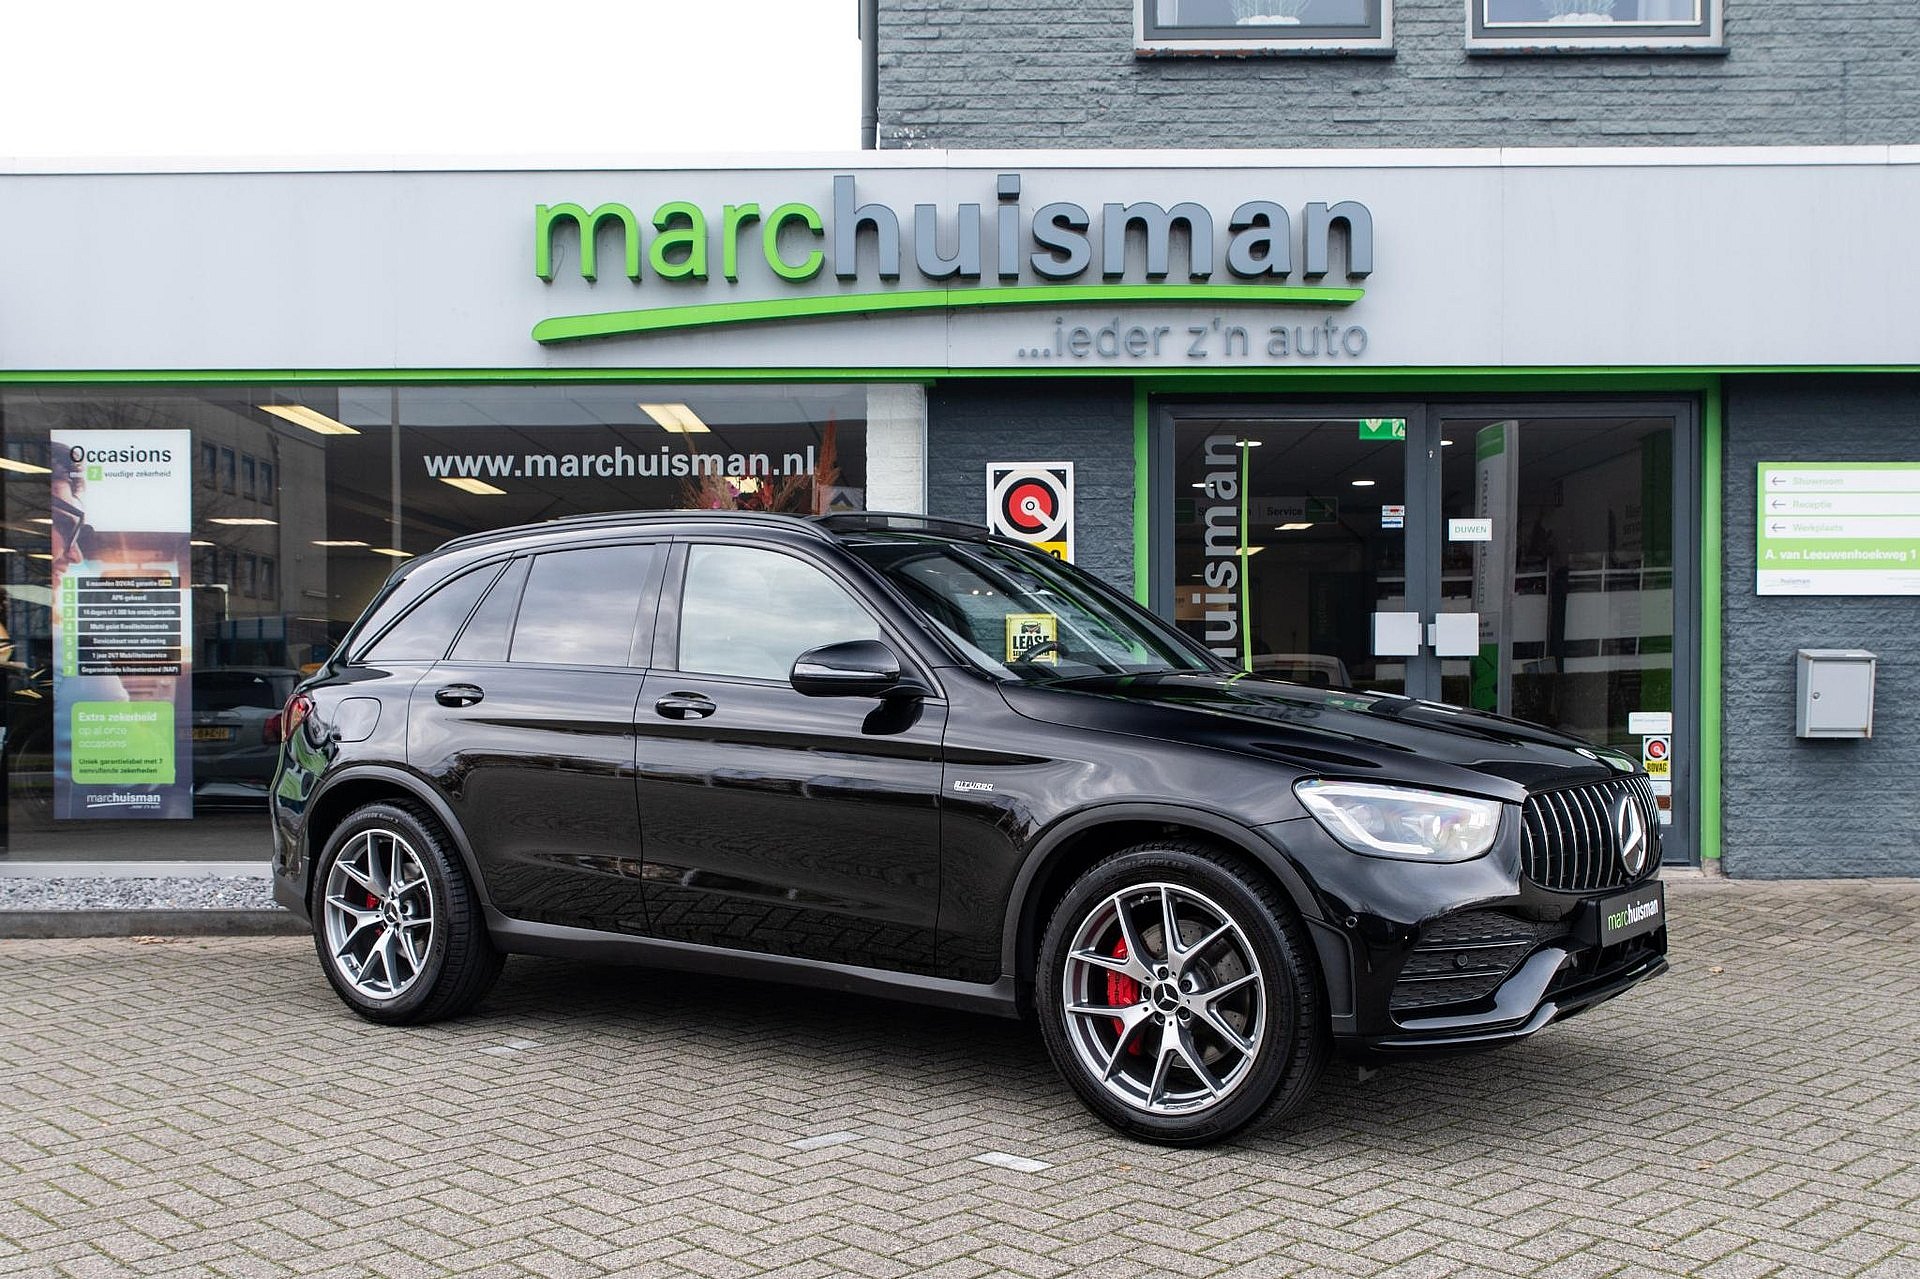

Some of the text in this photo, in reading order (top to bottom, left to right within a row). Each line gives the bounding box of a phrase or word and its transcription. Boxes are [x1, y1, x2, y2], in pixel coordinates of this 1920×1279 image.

[535, 175, 1374, 283] marchuisman
[1018, 316, 1366, 359] ...ieder z'n auto
[70, 445, 172, 463] Occasions
[423, 446, 815, 477] www.marchuisman.nl
[1266, 506, 1303, 516] Service
[1454, 525, 1487, 534] DUWEN
[1765, 549, 1777, 560] A.
[1780, 551, 1800, 560] van
[1803, 549, 1907, 561] Leeuwenhoekweg
[79, 711, 157, 721] Extra zekerheid
[1646, 762, 1667, 773] BOVAG
[86, 792, 161, 803] marchuisman
[1607, 899, 1659, 931] marchuisman
